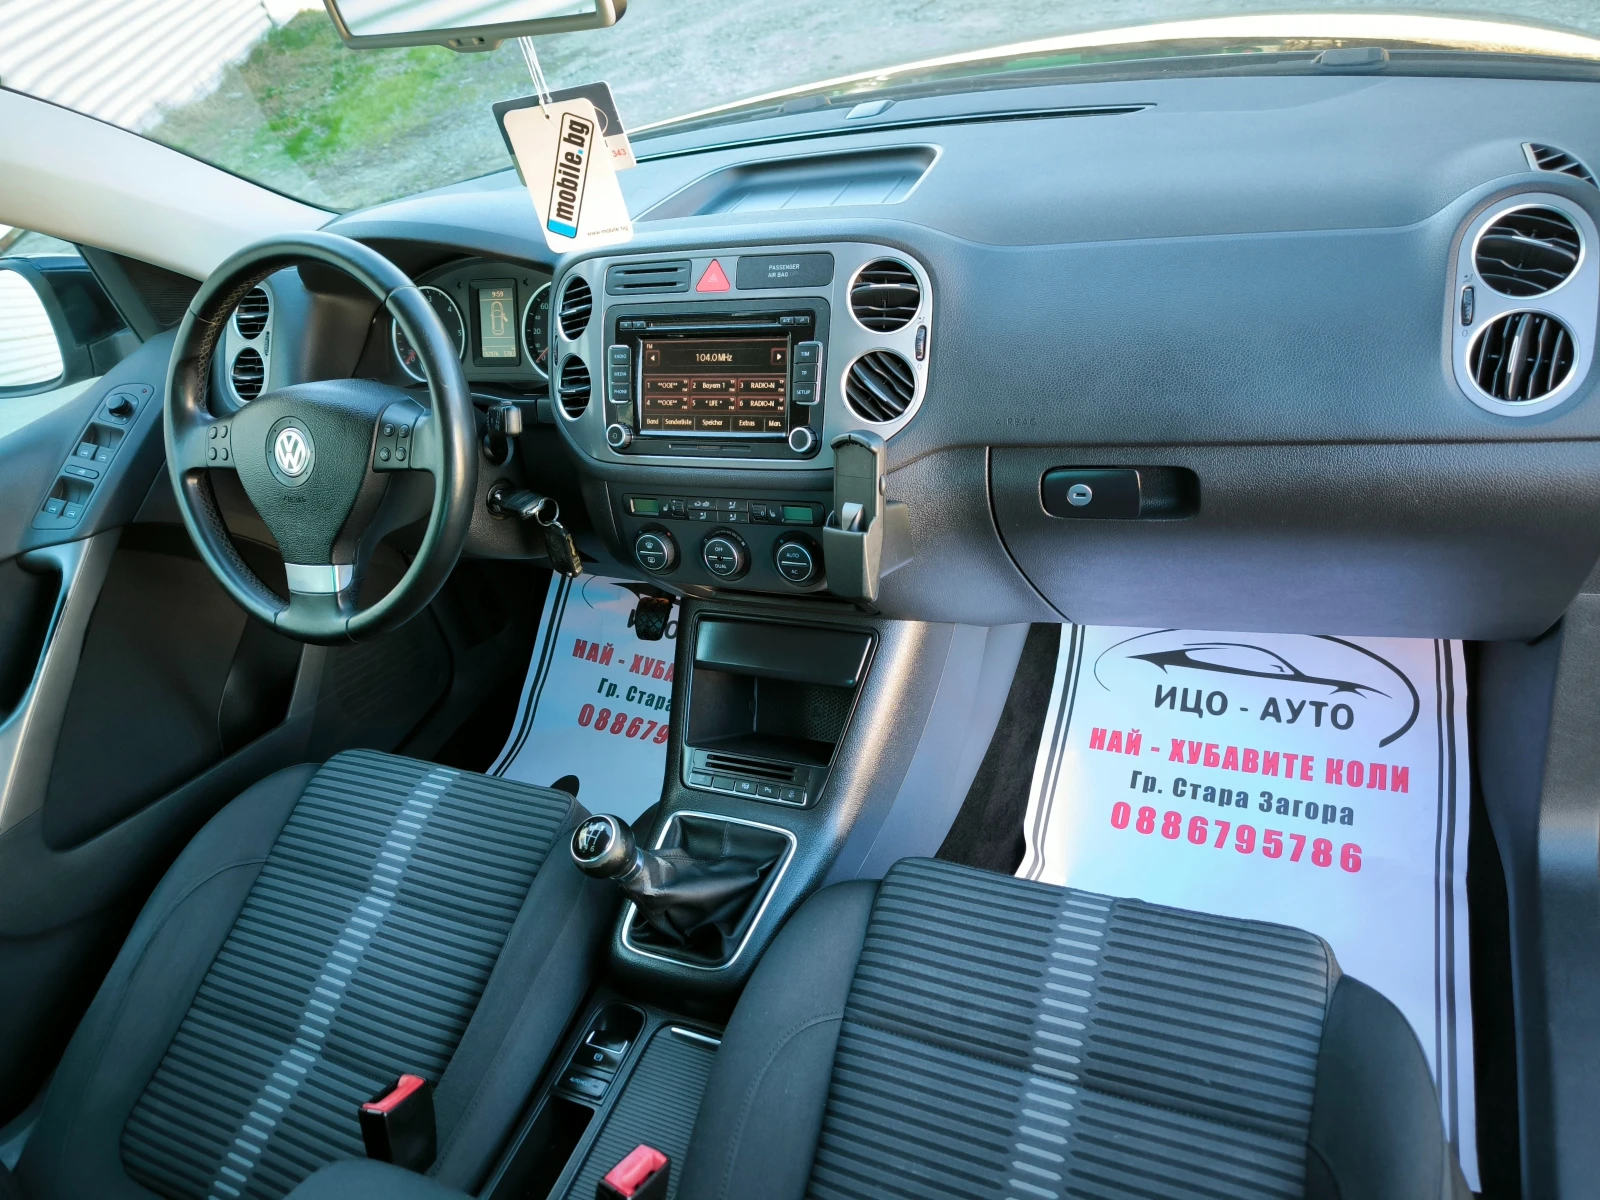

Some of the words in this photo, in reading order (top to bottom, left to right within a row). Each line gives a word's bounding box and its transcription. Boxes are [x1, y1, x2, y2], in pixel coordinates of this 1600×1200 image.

[611, 148, 627, 158] 343
[556, 119, 590, 222] mobile.bg
[768, 263, 800, 271] PASSENGER
[491, 290, 504, 298] 9:59
[427, 295, 433, 303] 3
[540, 302, 549, 310] 60
[457, 329, 462, 337] 5
[533, 327, 541, 335] 20
[665, 418, 693, 426] Senderliste
[702, 419, 723, 427] Speicher
[738, 419, 756, 427] Extras
[572, 638, 615, 666] НАЙ
[597, 677, 620, 698] Гр.
[625, 685, 673, 712] Стара
[1154, 684, 1229, 719] ИЦО
[1260, 697, 1355, 730] АУТО
[577, 703, 670, 745] 088679
[1088, 727, 1142, 756] НАЙ
[1168, 738, 1314, 782] ХУБАВИТЕ
[1325, 757, 1410, 794] КОЛИ
[1130, 770, 1163, 794] Гр.
[1172, 777, 1250, 809] Стара
[1258, 791, 1355, 826] Загора
[1110, 801, 1363, 873] 0886795786
